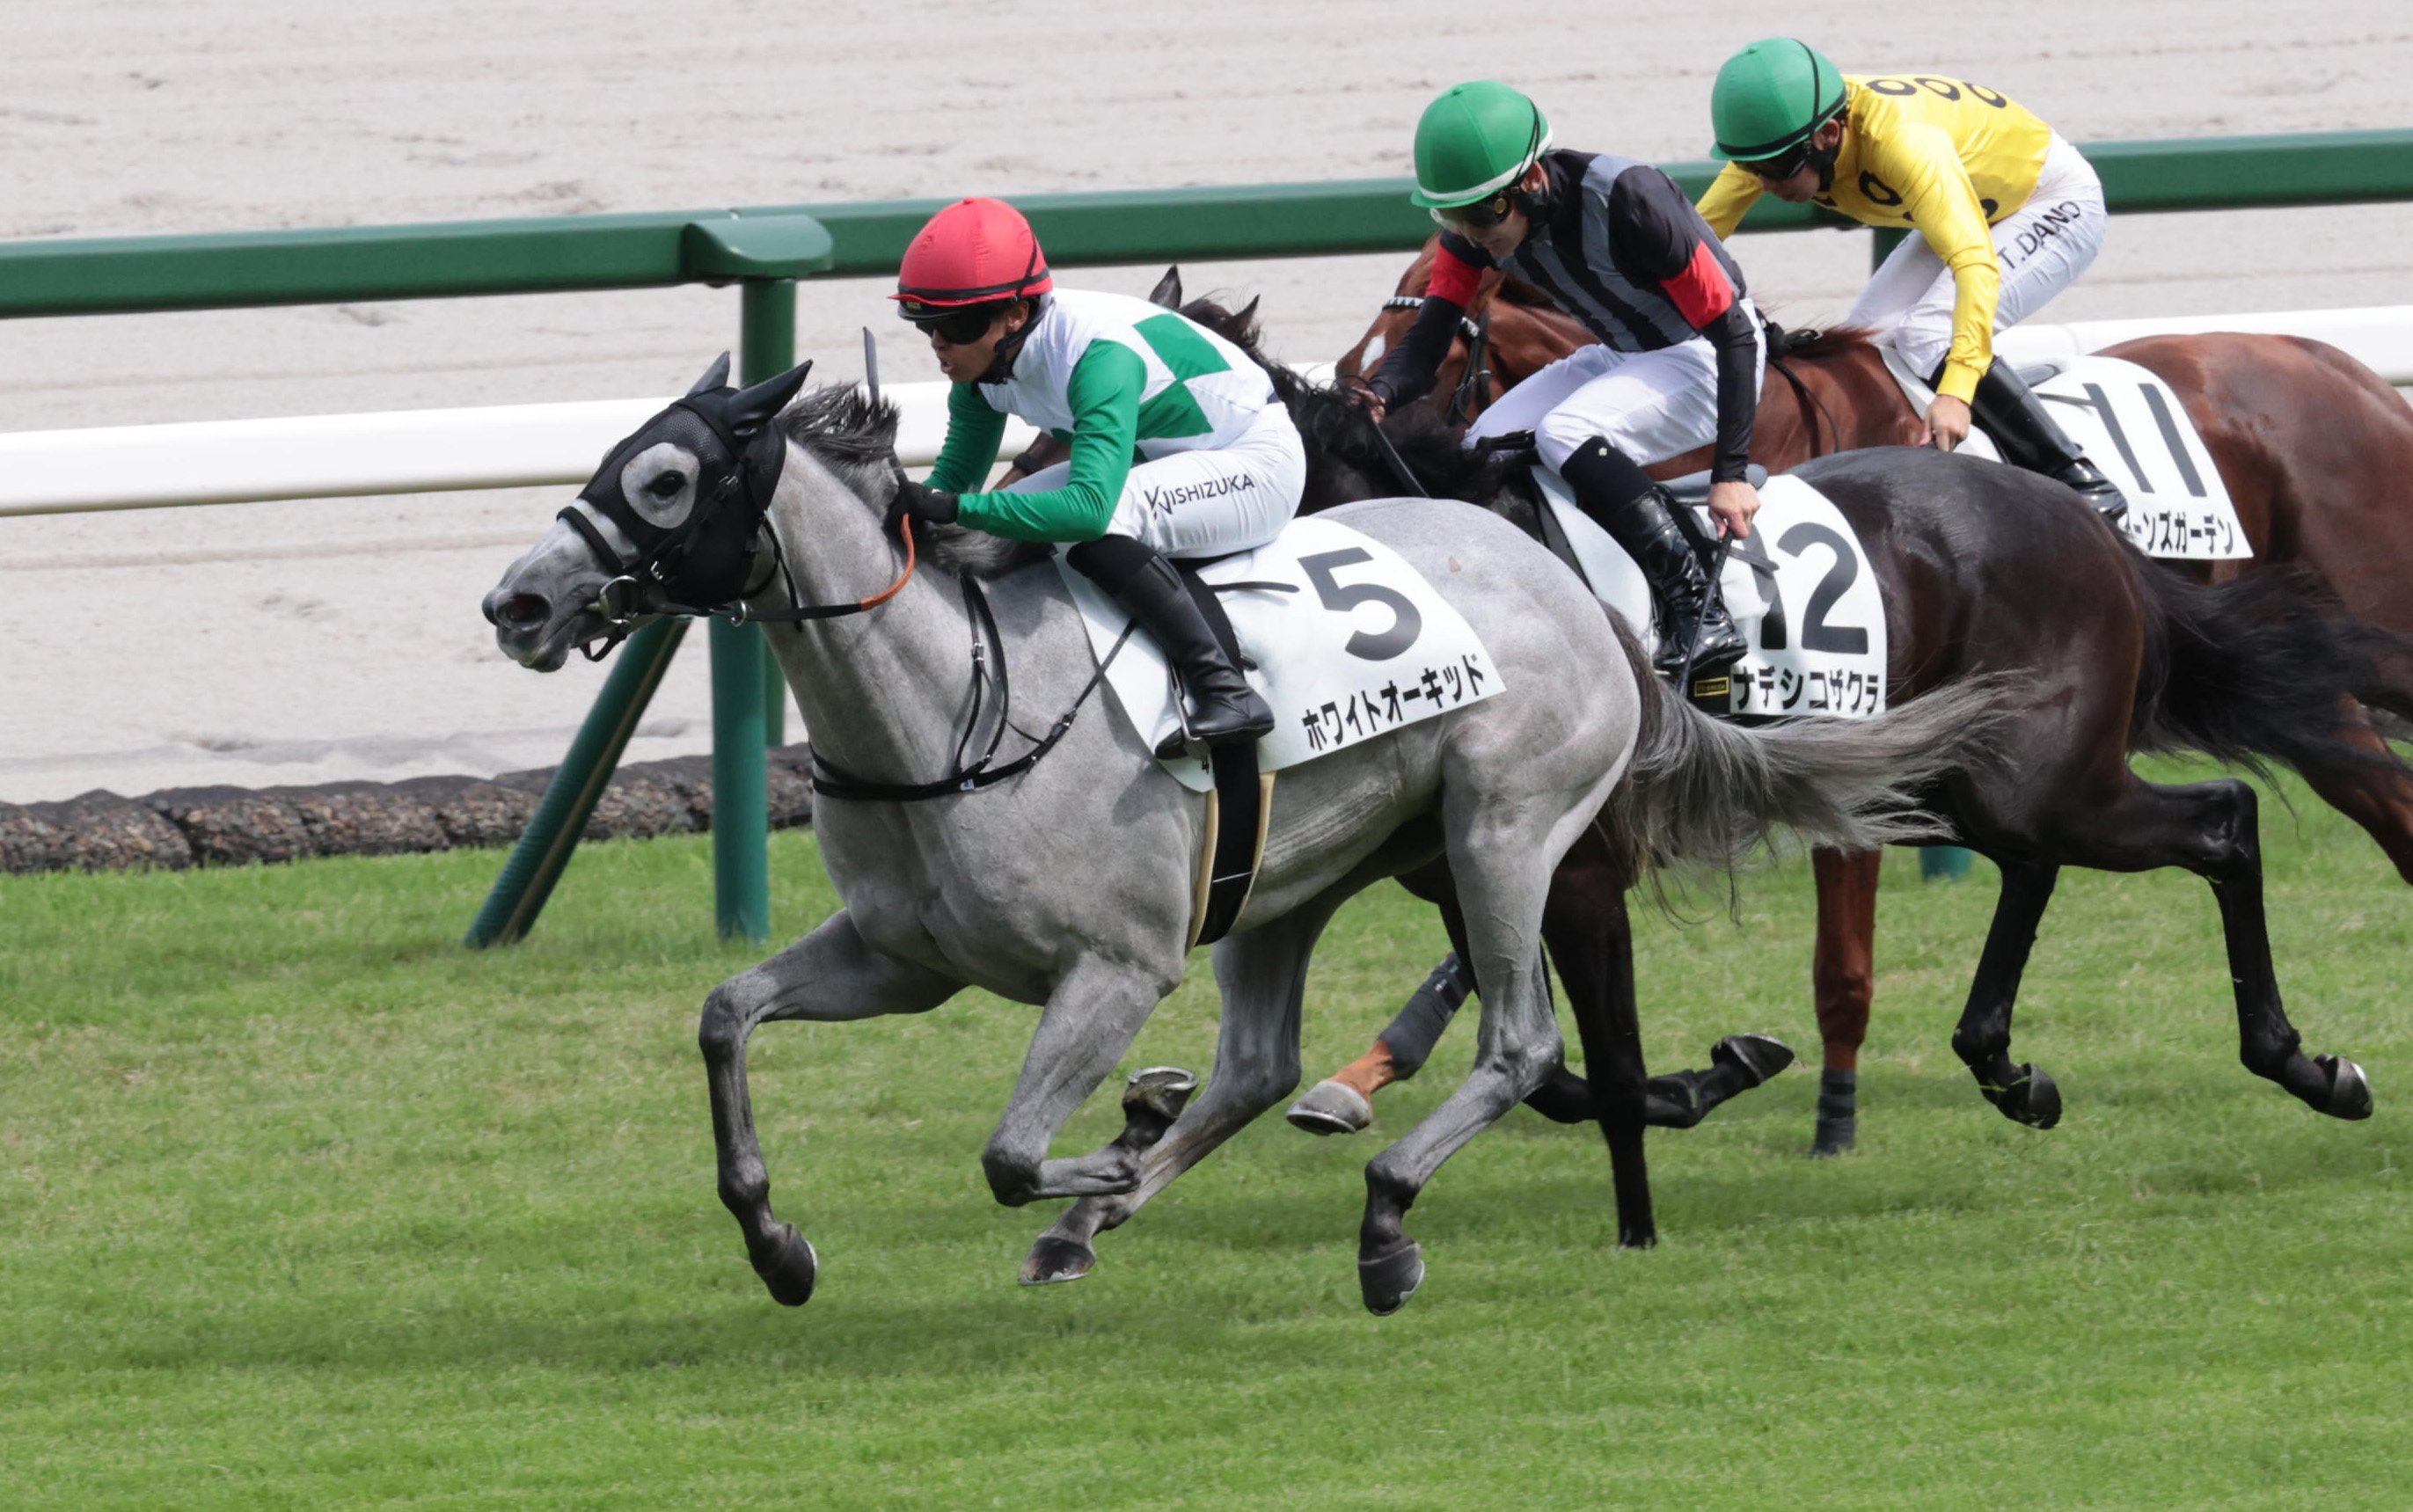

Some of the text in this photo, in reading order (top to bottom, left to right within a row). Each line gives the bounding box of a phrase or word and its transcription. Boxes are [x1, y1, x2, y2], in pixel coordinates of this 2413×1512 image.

[2082, 383, 2207, 497] 11
[1298, 546, 1422, 661] 5
[1740, 521, 1868, 654] 12
[1302, 654, 1484, 751] ホワイトオーキッド
[1733, 666, 1879, 714] ナデシコザクラ
